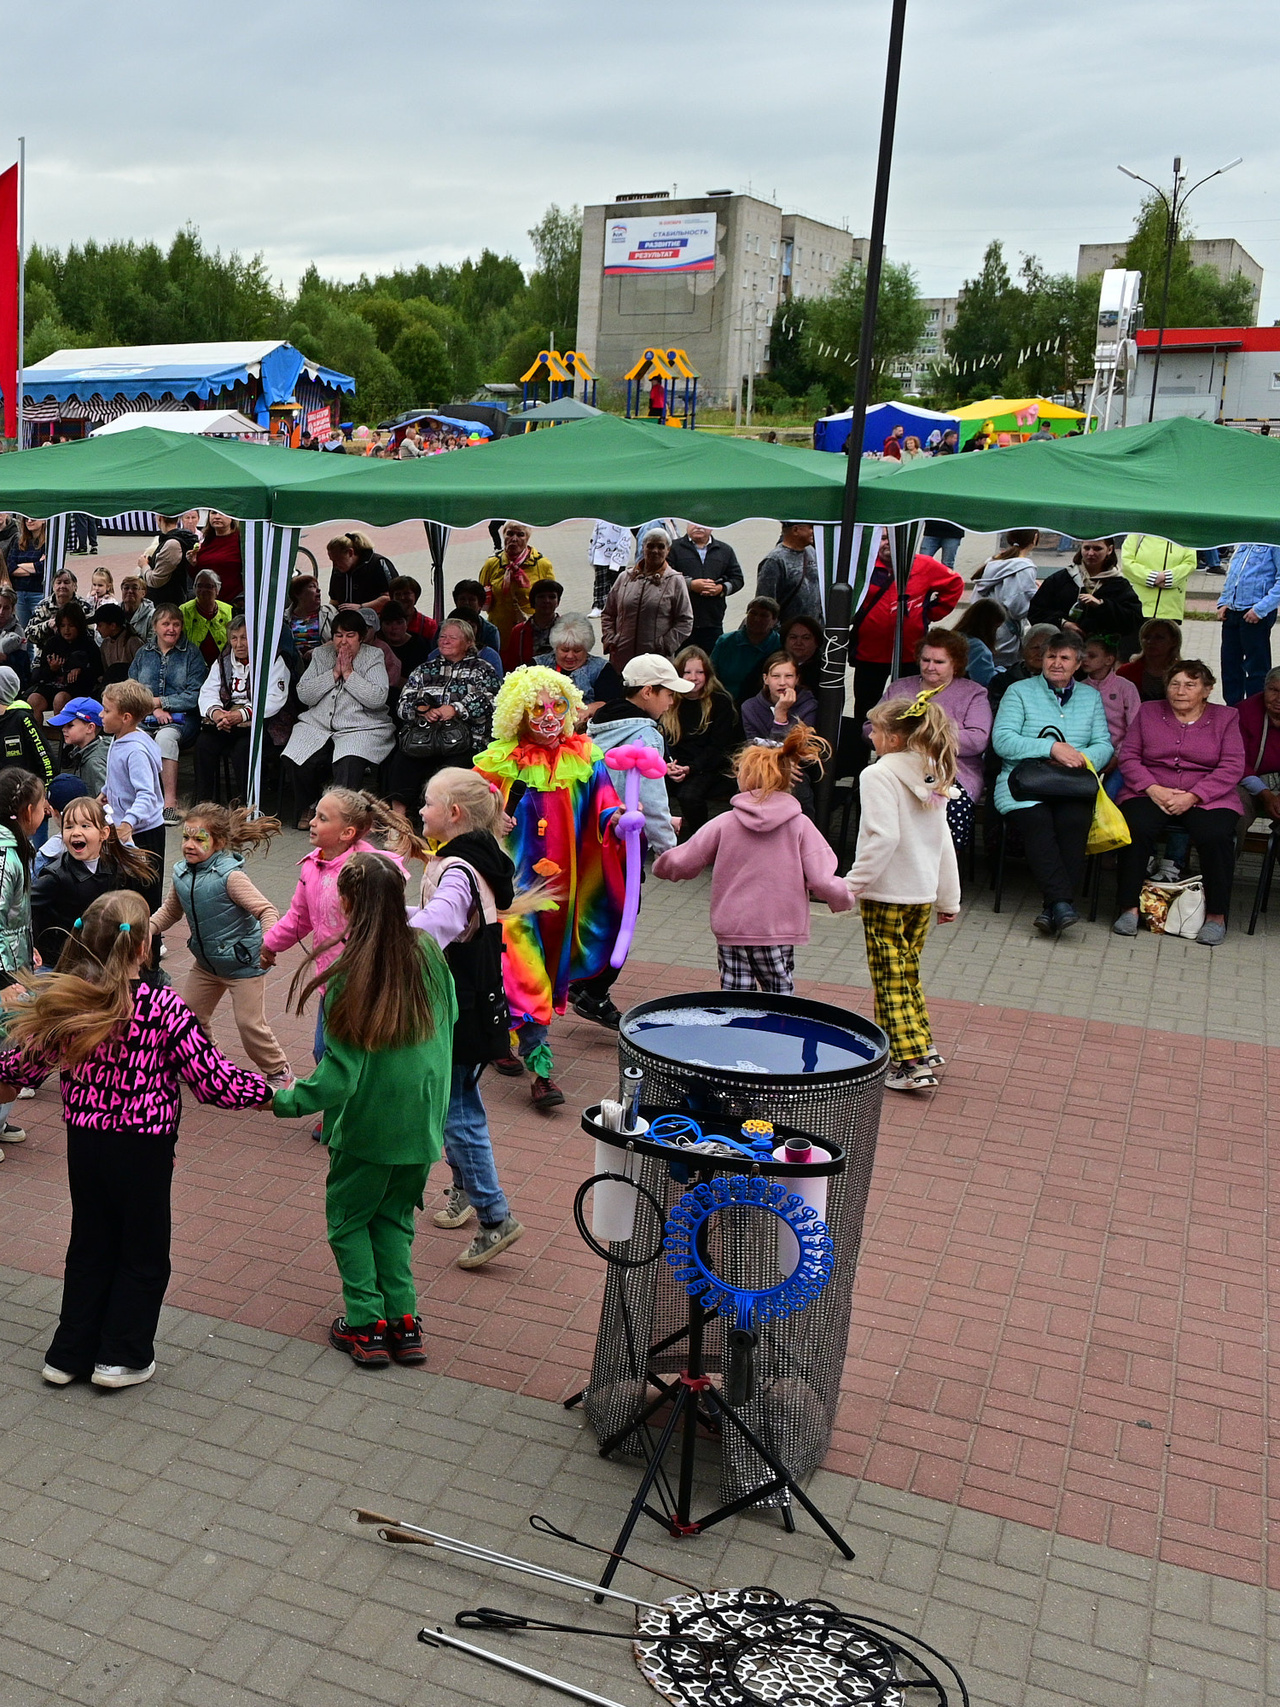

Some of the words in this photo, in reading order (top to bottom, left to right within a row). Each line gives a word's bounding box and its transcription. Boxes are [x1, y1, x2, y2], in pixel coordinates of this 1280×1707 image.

[652, 229, 708, 238] СТАБИЛЬНОСТЬ
[644, 240, 681, 248] РАЗВИТИЕ
[634, 251, 674, 259] РЕЗУЛЬТАТ
